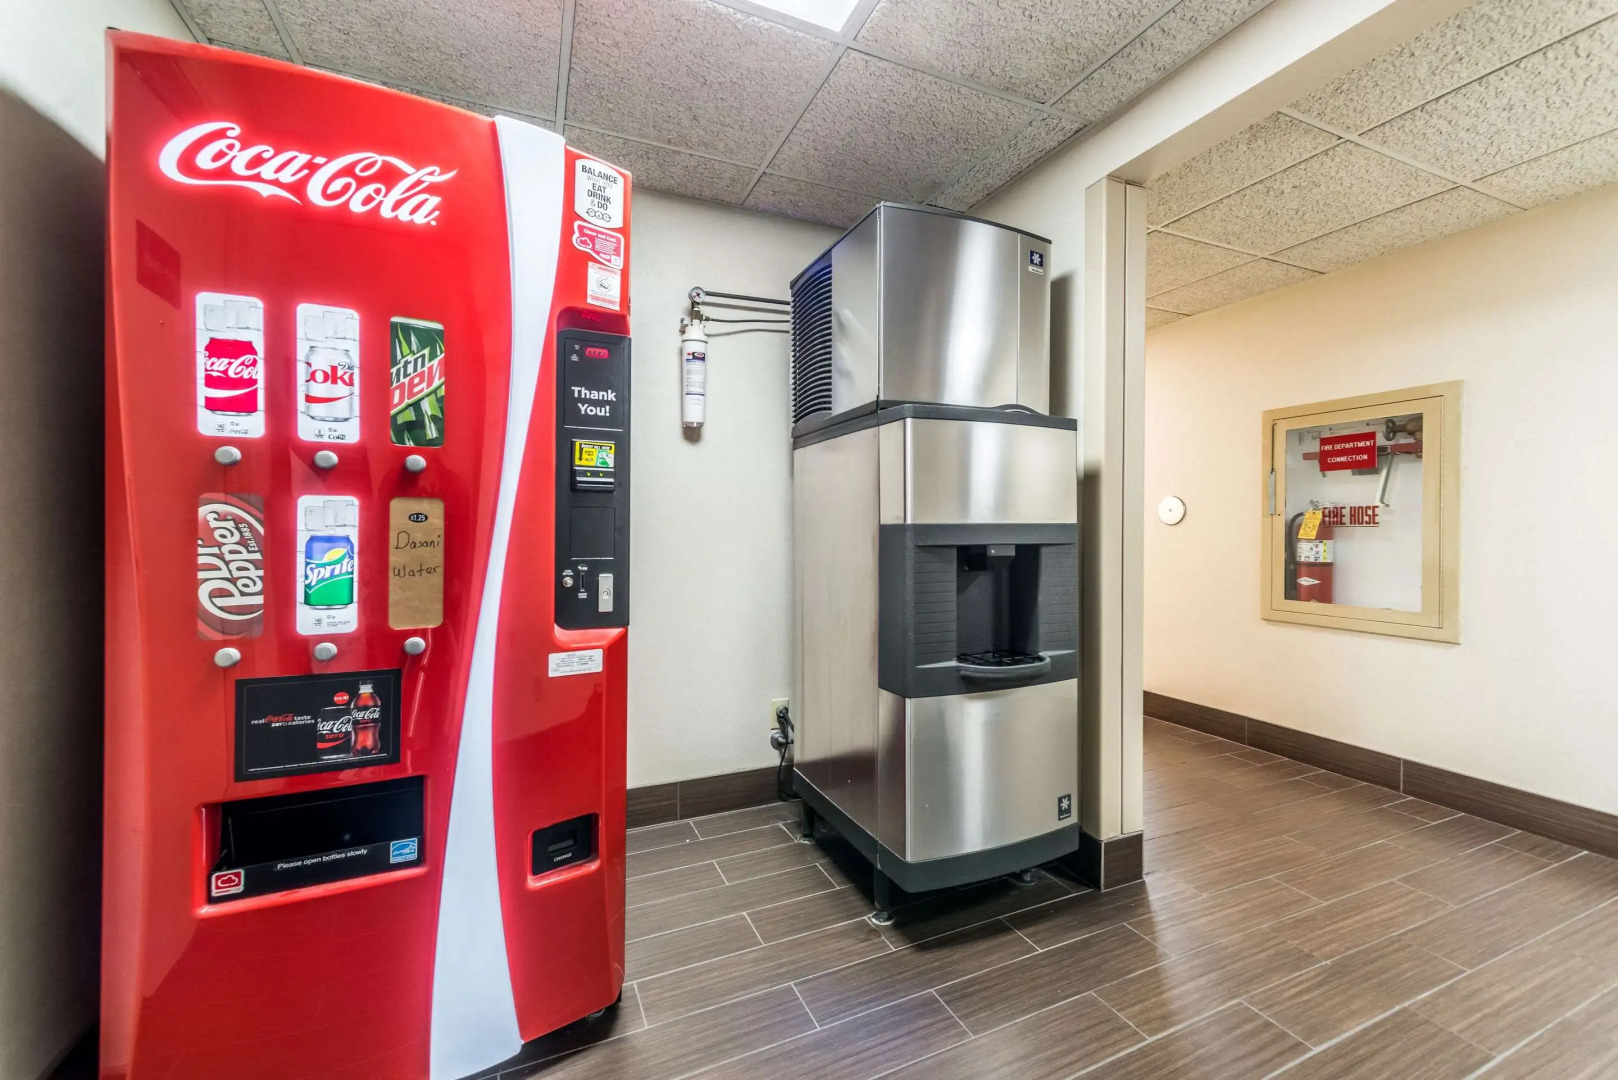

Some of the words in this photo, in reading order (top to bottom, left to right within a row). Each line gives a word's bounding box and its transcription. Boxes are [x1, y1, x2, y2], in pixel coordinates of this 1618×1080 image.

[159, 121, 458, 225] Coca-Cola
[581, 164, 618, 185] BALANCE
[592, 183, 607, 194] EAT
[587, 189, 611, 205] DRINK
[590, 198, 597, 207] &
[597, 201, 608, 211] DO
[571, 386, 617, 402] Thank
[577, 403, 610, 417] You!
[1334, 439, 1375, 450] DEPARTMENT
[1327, 454, 1368, 463] CONNECTION
[1322, 506, 1346, 525] FIRE
[1349, 505, 1380, 525] HOSE
[238, 522, 254, 540] 1885
[395, 530, 441, 550] Dasani
[197, 509, 264, 620] Pepper
[305, 553, 354, 587] Sprite
[393, 565, 442, 579] Water
[277, 859, 302, 870] Please
[303, 857, 322, 867] open
[322, 852, 346, 864] bottles
[346, 847, 368, 858] slowly
[553, 852, 573, 862] CHANGE
